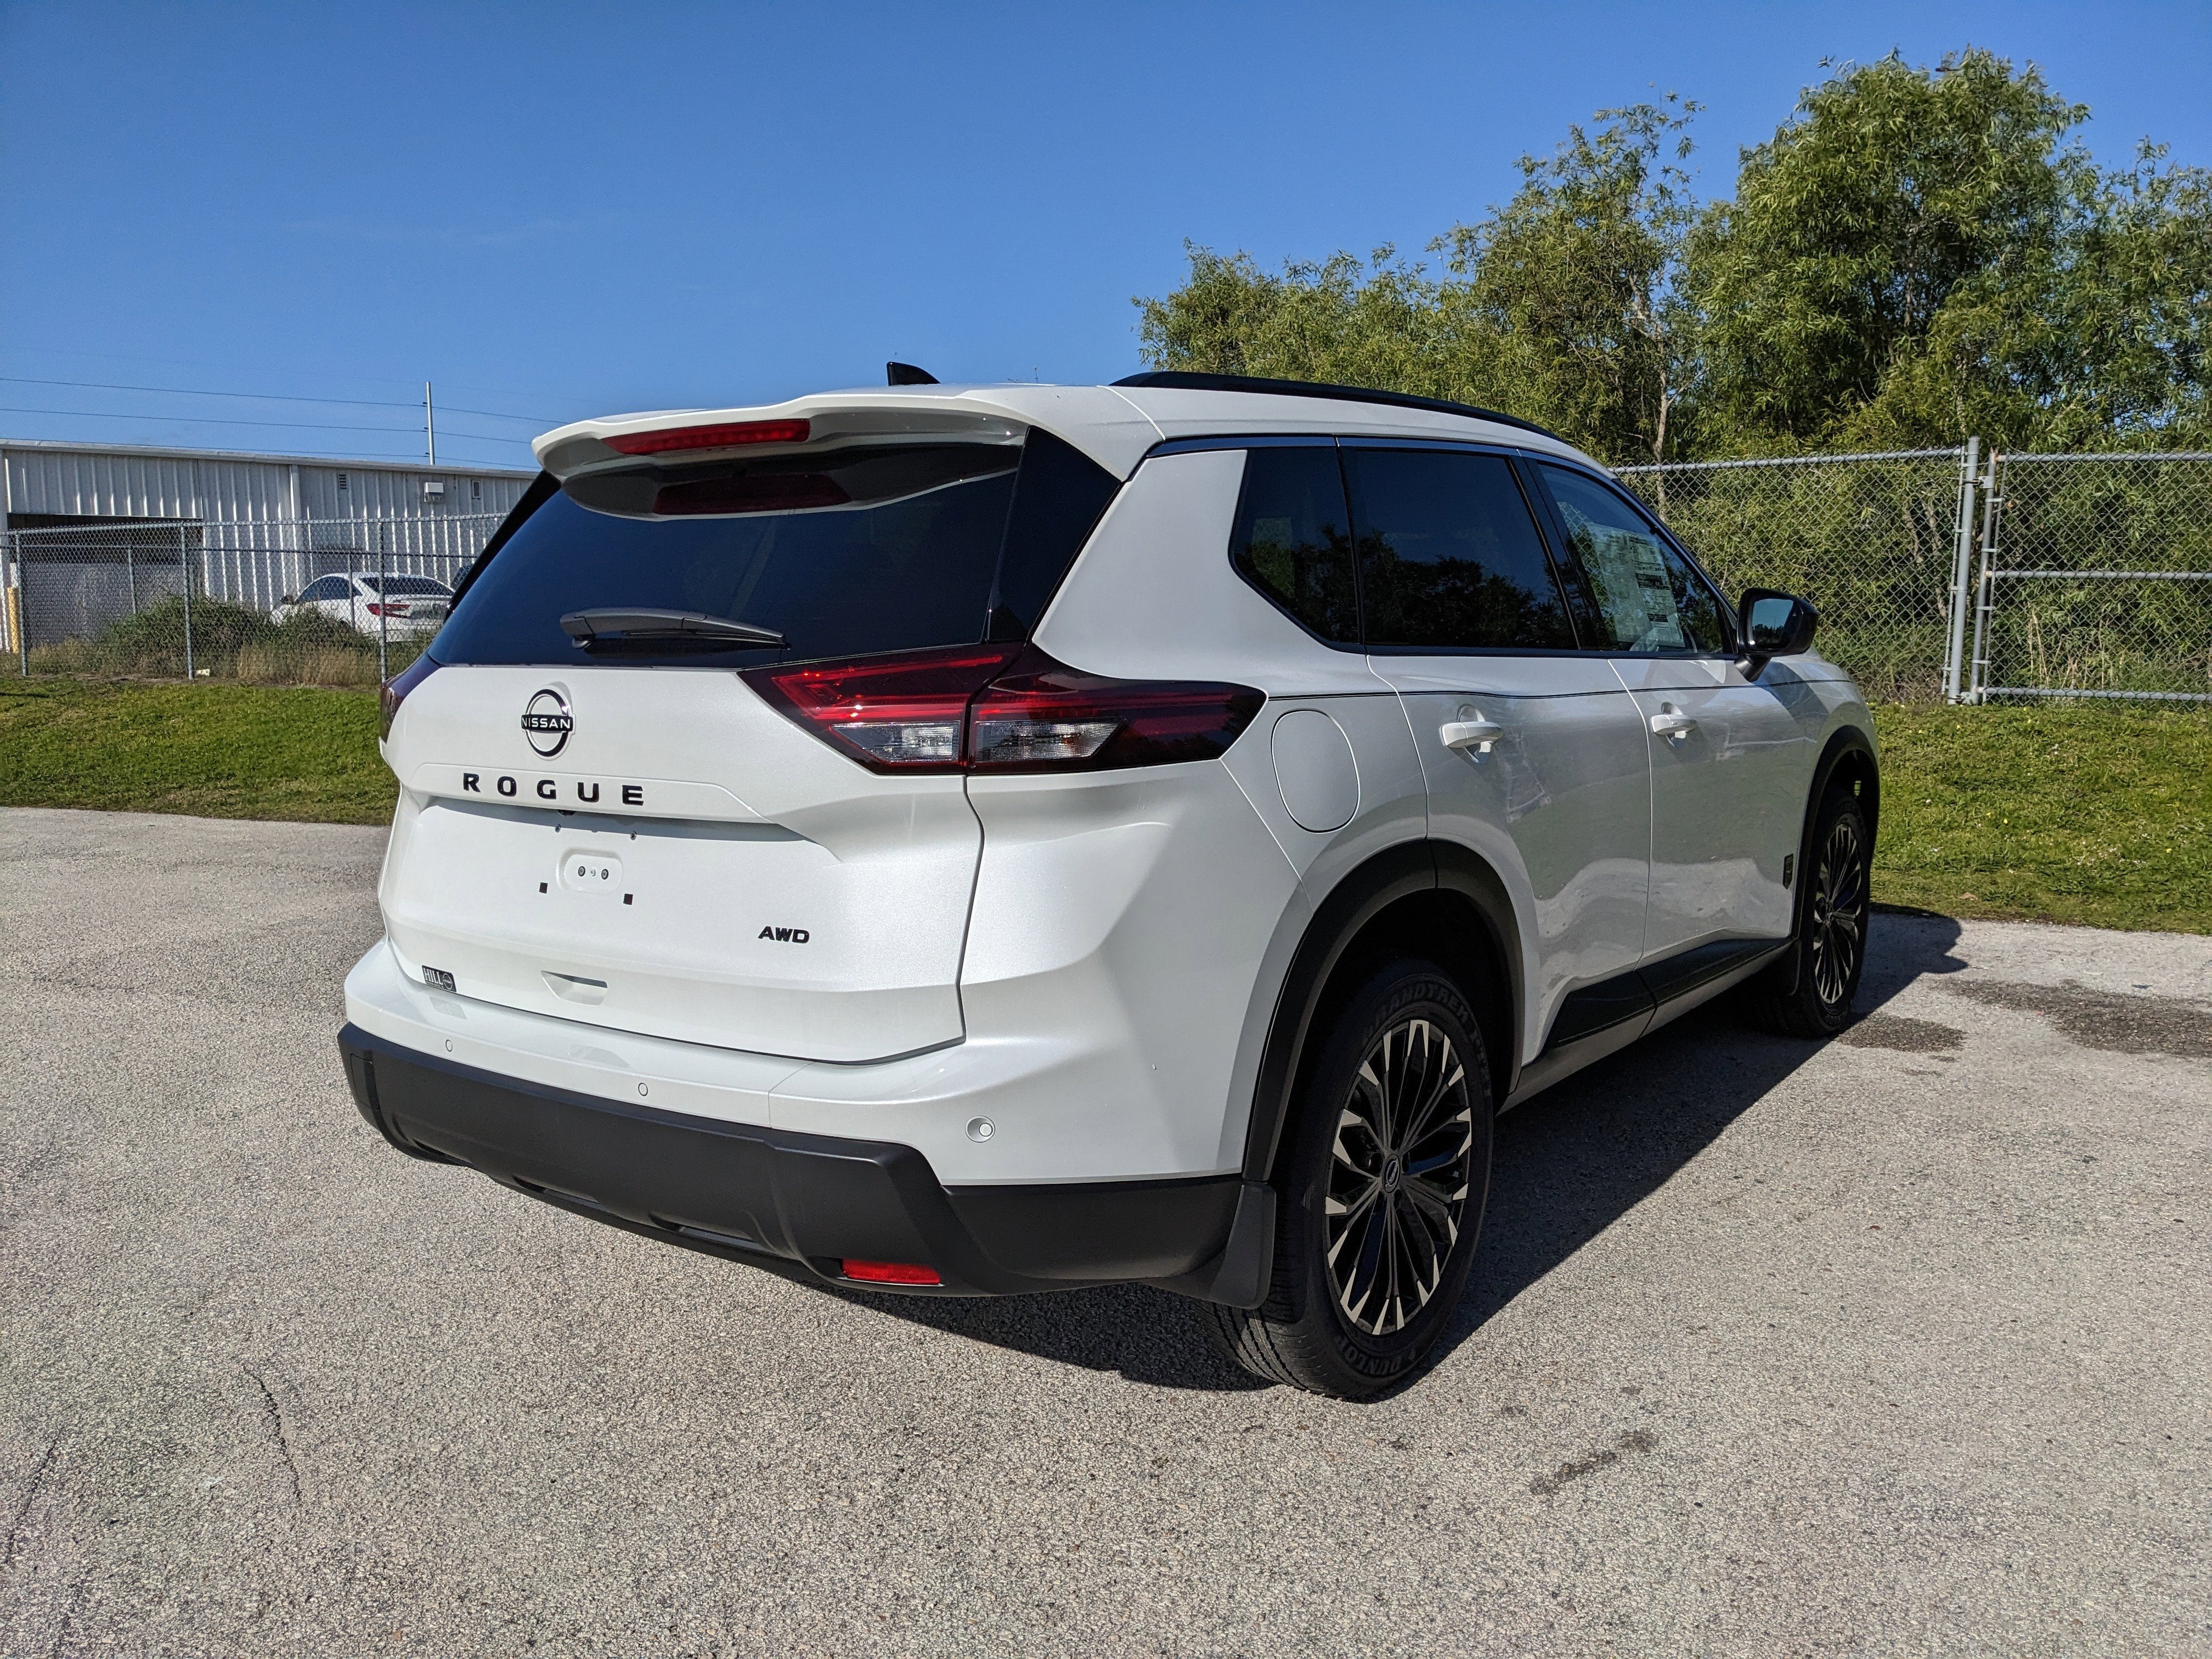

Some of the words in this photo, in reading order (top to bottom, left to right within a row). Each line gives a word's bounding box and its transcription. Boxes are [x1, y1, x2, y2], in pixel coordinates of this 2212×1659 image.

[522, 716, 571, 729] NISSAN
[463, 772, 644, 806] ROGUE
[758, 926, 810, 944] AWD
[423, 967, 443, 985] HILL
